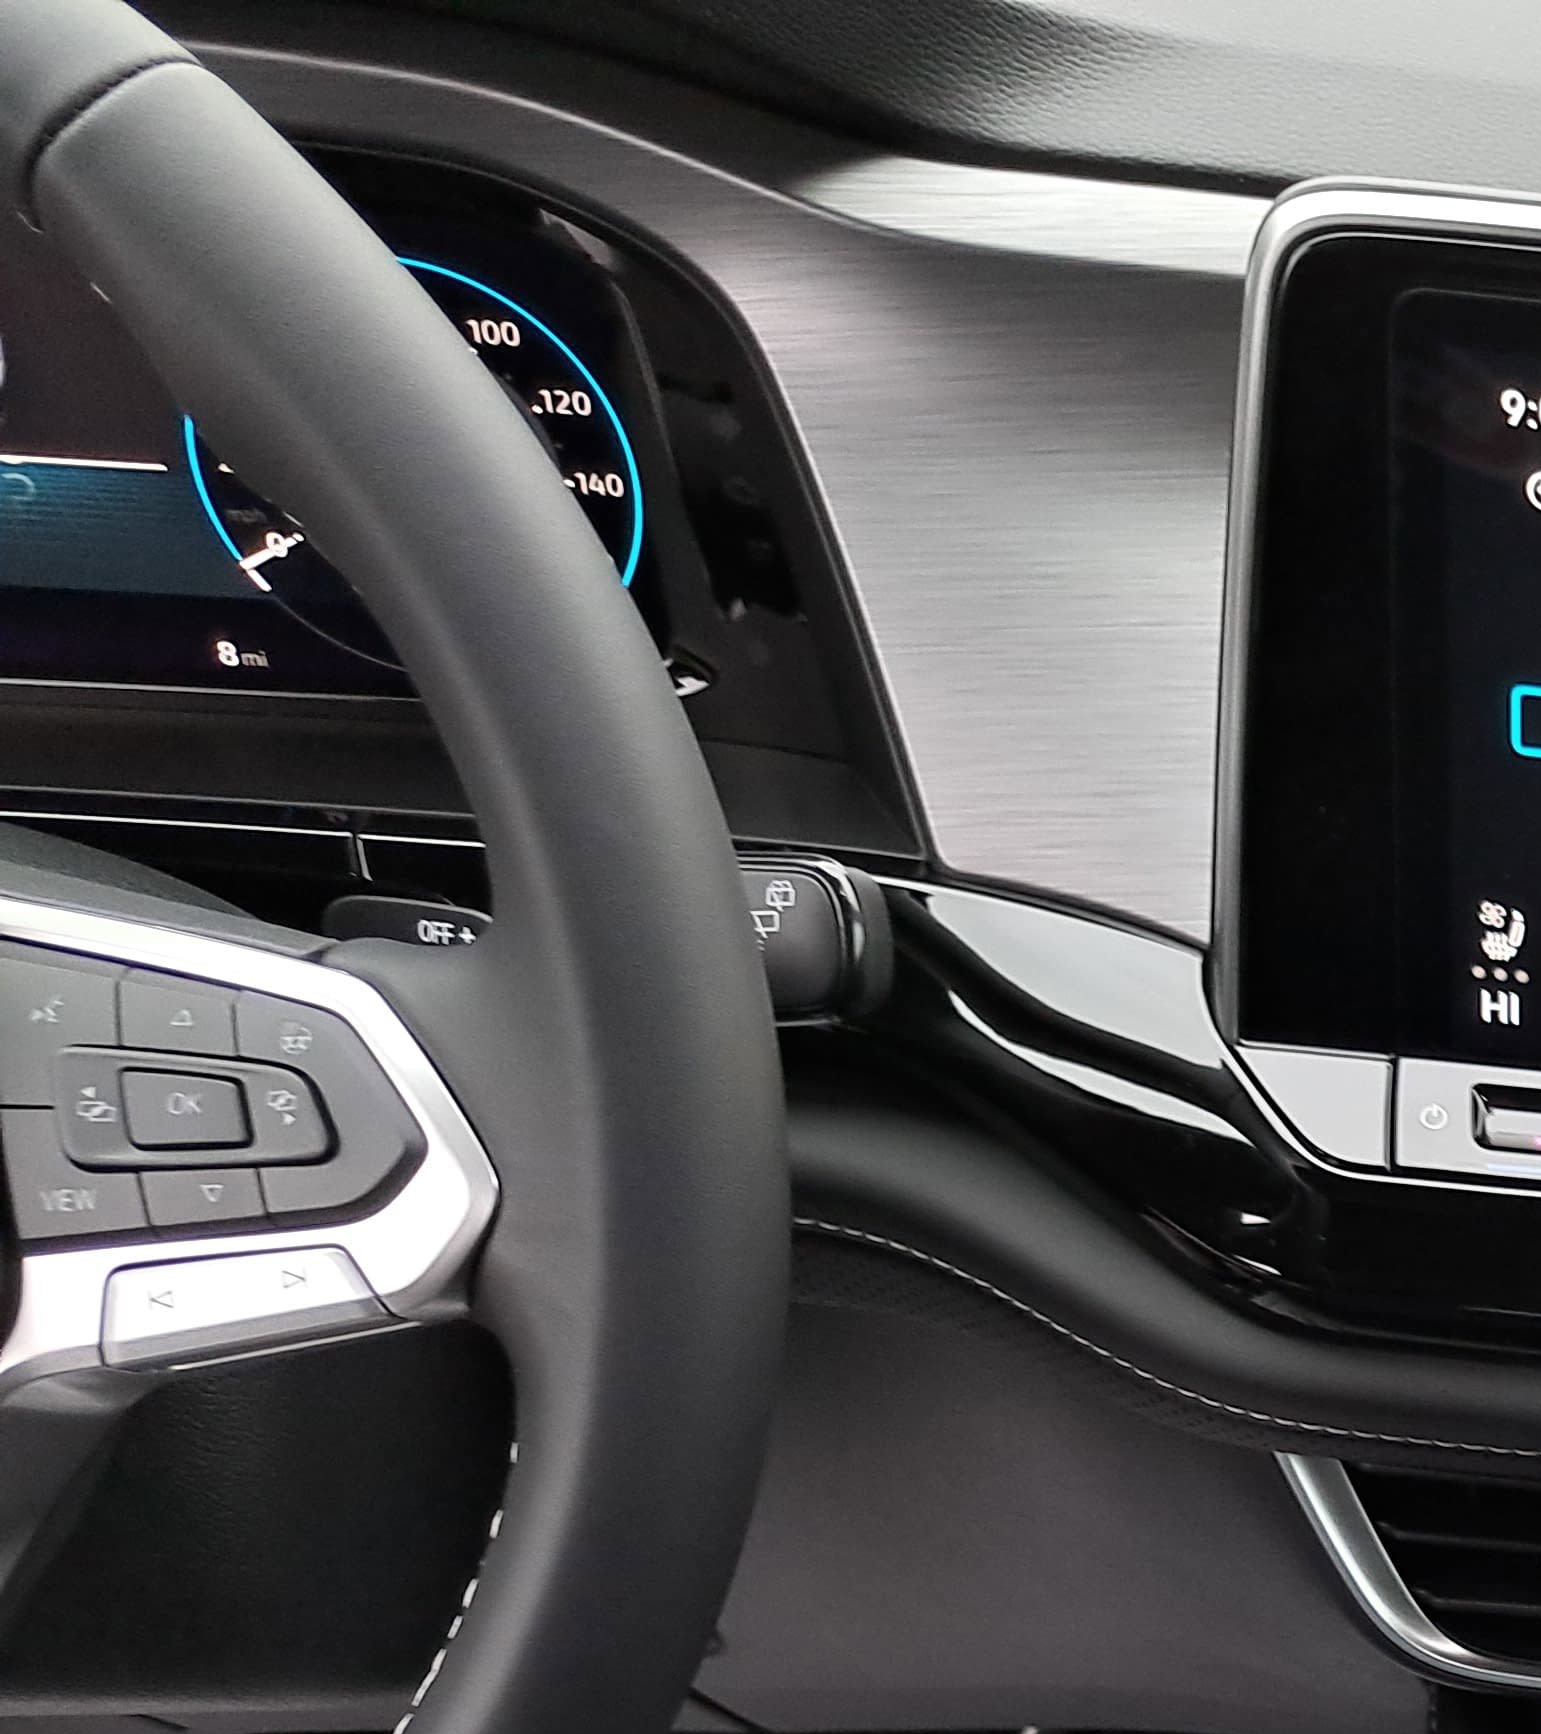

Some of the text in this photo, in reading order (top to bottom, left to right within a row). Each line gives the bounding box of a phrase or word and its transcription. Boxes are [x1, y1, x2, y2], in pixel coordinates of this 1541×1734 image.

[465, 319, 521, 348] 100
[537, 388, 592, 417] 120
[573, 471, 625, 498] 140
[216, 640, 240, 668] 8
[416, 919, 456, 946] OFF
[1479, 987, 1521, 1027] HI
[166, 1091, 203, 1116] OK
[39, 1187, 97, 1212] VIEW
